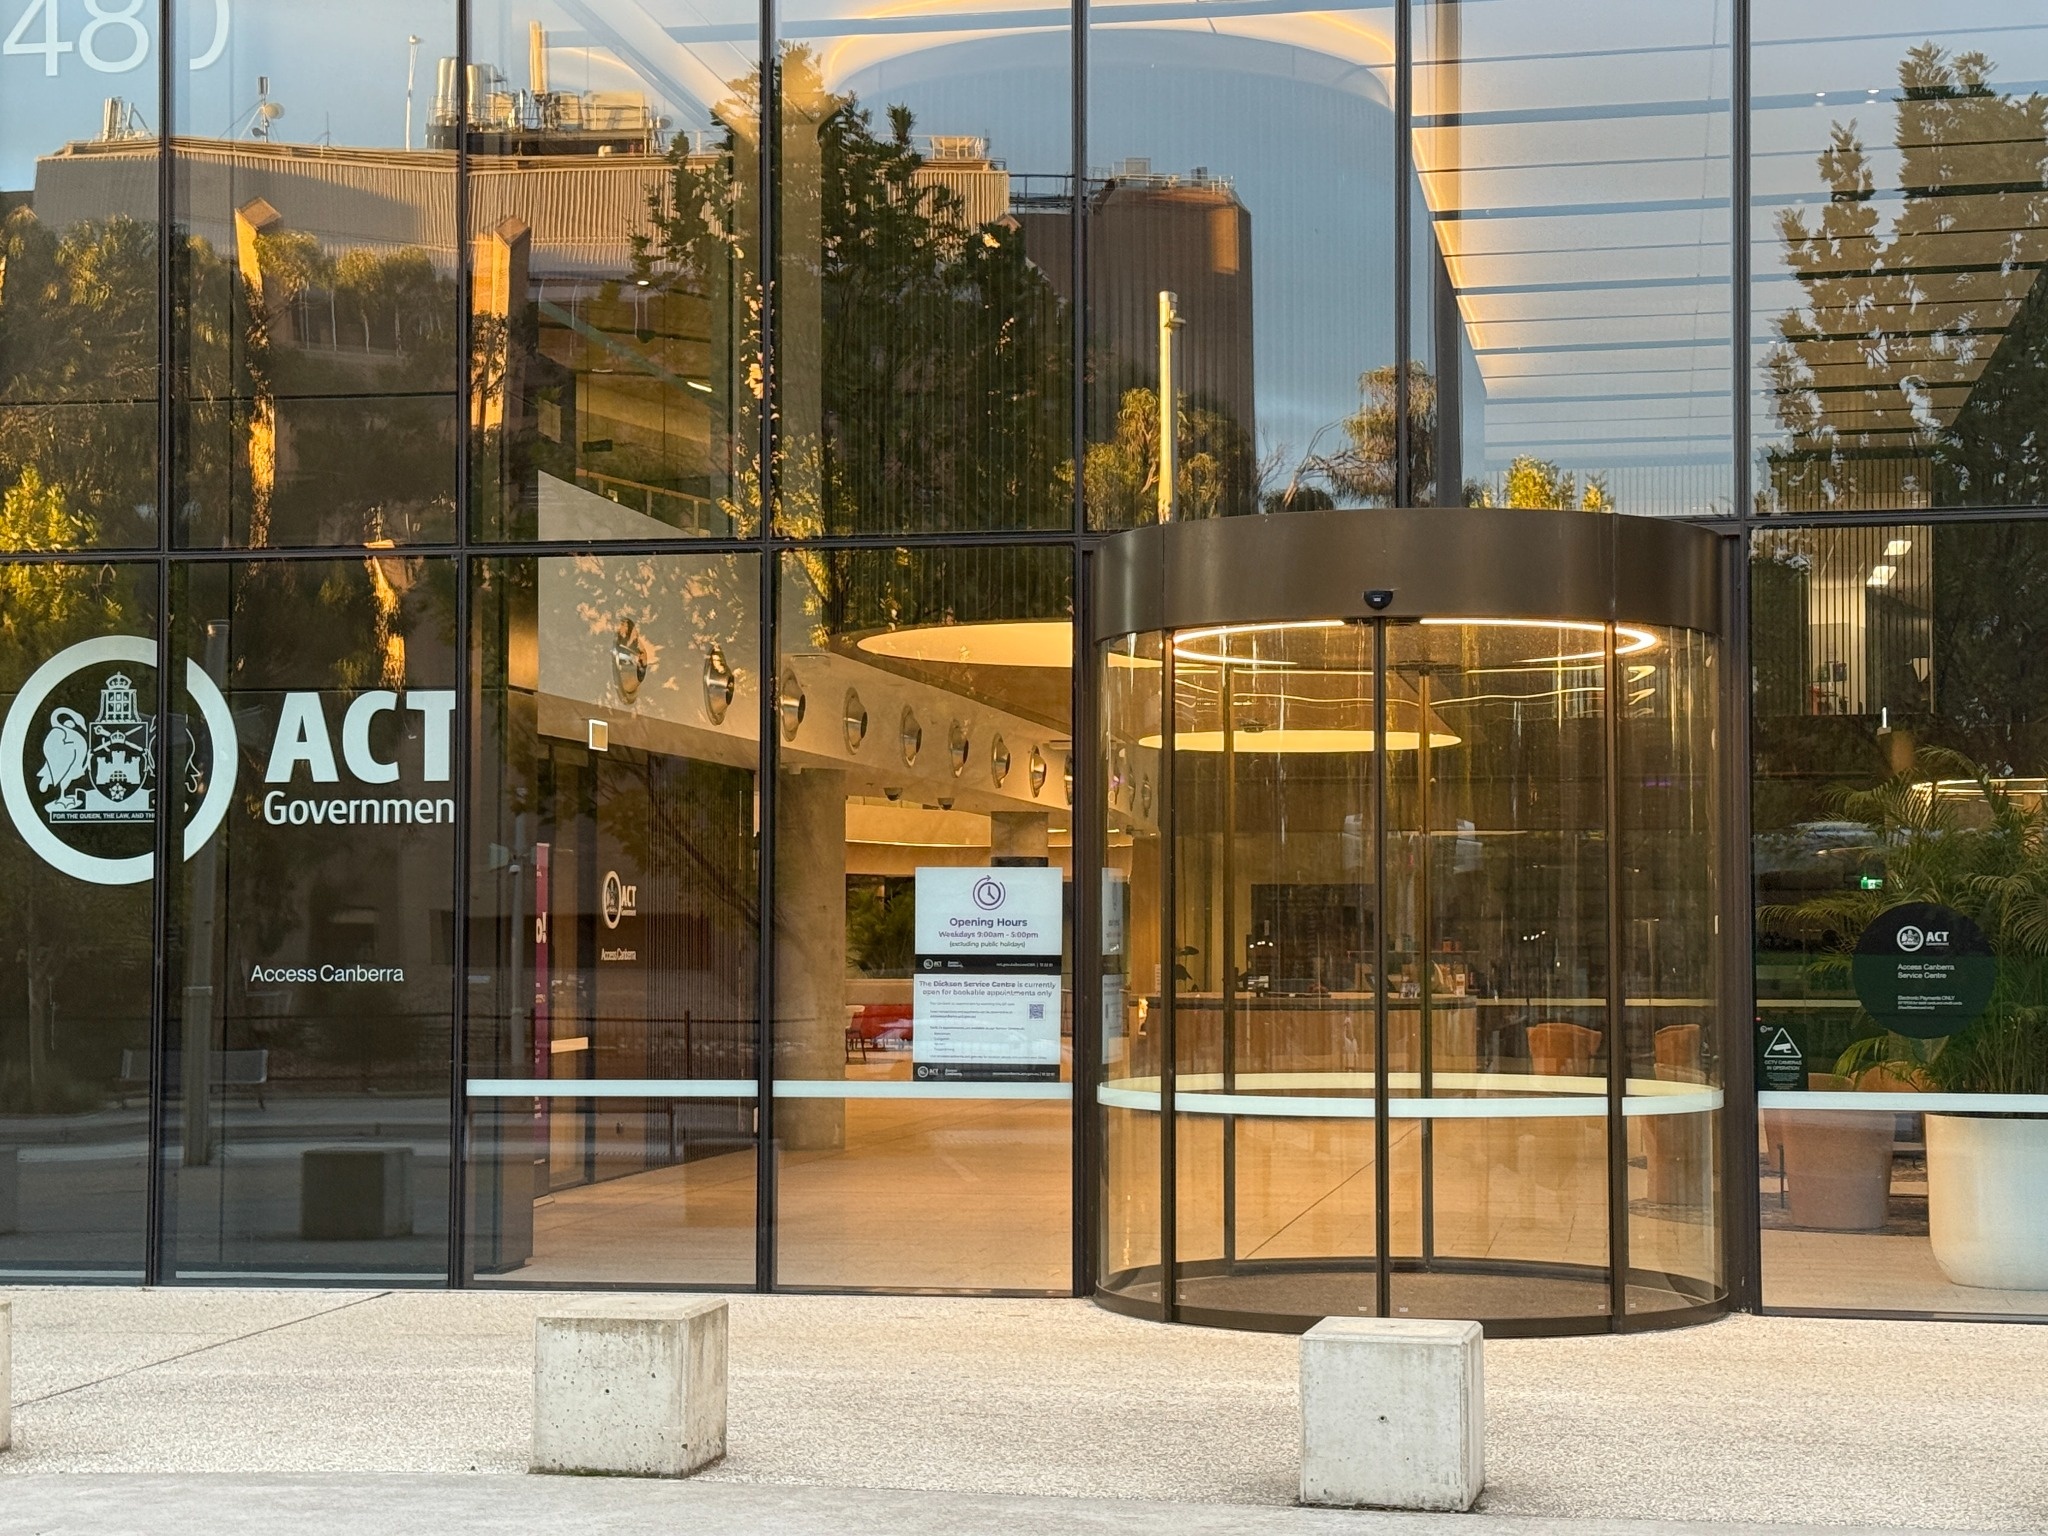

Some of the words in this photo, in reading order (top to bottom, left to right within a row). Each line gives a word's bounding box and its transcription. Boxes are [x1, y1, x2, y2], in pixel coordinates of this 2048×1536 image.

[265, 690, 456, 784] ACT
[264, 791, 455, 825] Governmen
[621, 885, 637, 908] ACT
[949, 917, 994, 928] Opening
[997, 917, 1028, 927] Hours
[938, 930, 976, 939] Weekdays
[1011, 931, 1039, 939] 5:00pm
[1926, 931, 1950, 942] ACT
[1897, 963, 1922, 971] Access
[1923, 963, 1955, 971] Canberra
[251, 965, 317, 982] Access
[320, 964, 404, 982] Canberra
[1897, 971, 1923, 979] Service
[1924, 971, 1947, 979] Centre
[1024, 981, 1056, 989] currently
[922, 989, 941, 997] open
[986, 990, 1035, 998] appointments
[1037, 990, 1053, 998] only
